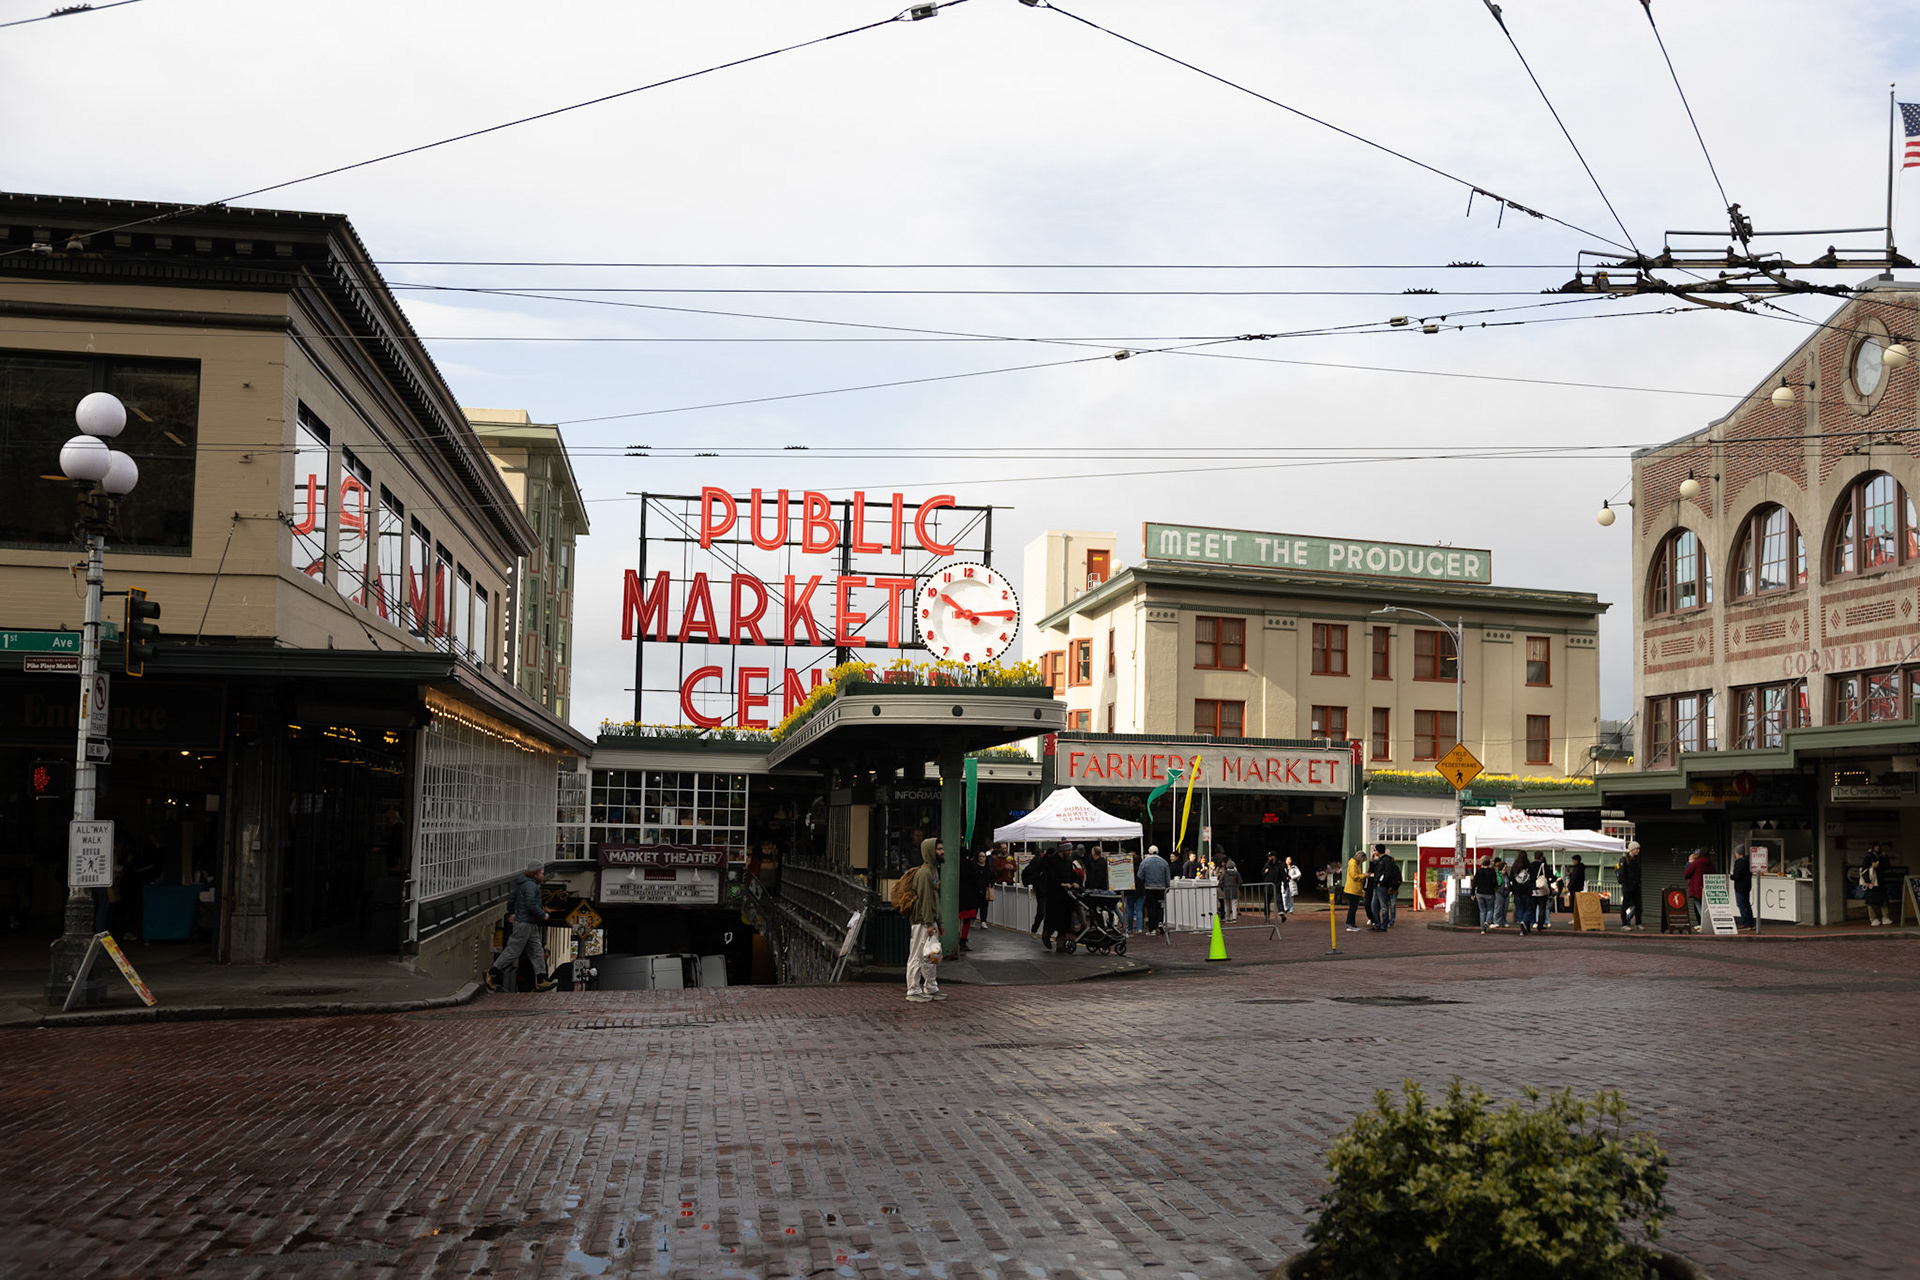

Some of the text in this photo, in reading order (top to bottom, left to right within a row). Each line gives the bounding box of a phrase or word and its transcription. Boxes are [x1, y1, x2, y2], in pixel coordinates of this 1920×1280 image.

[700, 486, 955, 556] PUBLIC
[1160, 530, 1479, 577] MEET THE PRODUCER
[943, 573, 951, 582] 11
[964, 568, 974, 577] 12
[928, 588, 937, 597] 10
[1002, 590, 1008, 600] 2
[621, 569, 915, 648] MARKET
[922, 609, 929, 619] 9
[927, 630, 934, 640] 8
[999, 632, 1007, 642] 4
[3, 634, 73, 648] 1st Ave
[942, 647, 949, 656] 7
[986, 648, 992, 657] 5
[963, 653, 970, 662] 6
[1783, 645, 1867, 676] CORNER
[23, 692, 166, 731] Entnce
[1070, 752, 1339, 783] FARMERS MARKET
[895, 791, 942, 799] INFORMAT
[1499, 814, 1547, 824] MARKET
[76, 826, 108, 834] ALL WAY
[1516, 824, 1563, 833] CENTER
[82, 836, 102, 844] WALK
[608, 852, 717, 864] MARKET THEATER
